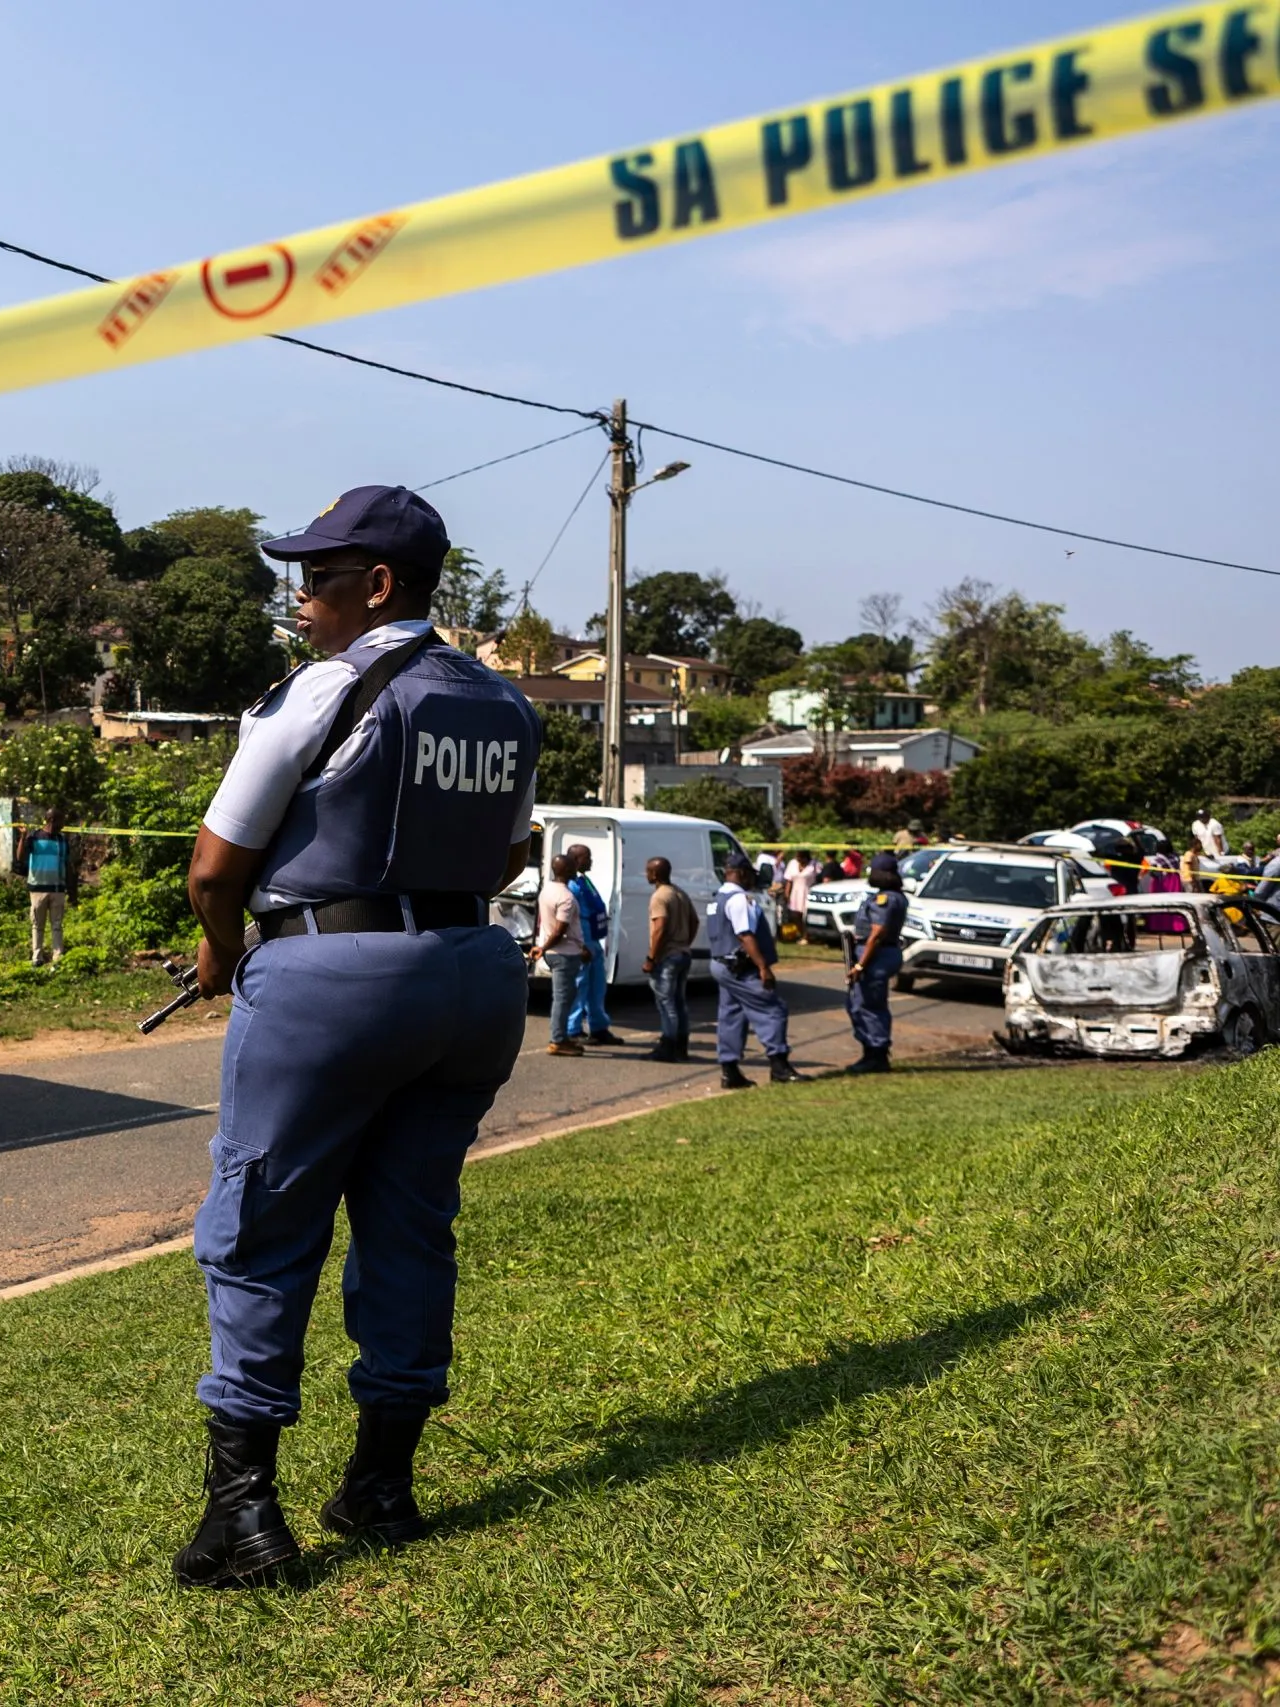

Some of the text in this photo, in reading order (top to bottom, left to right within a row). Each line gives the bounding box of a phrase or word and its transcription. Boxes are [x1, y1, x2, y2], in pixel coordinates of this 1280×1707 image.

[609, 3, 1280, 241] SA POLICE SE
[414, 731, 518, 793] POLICE
